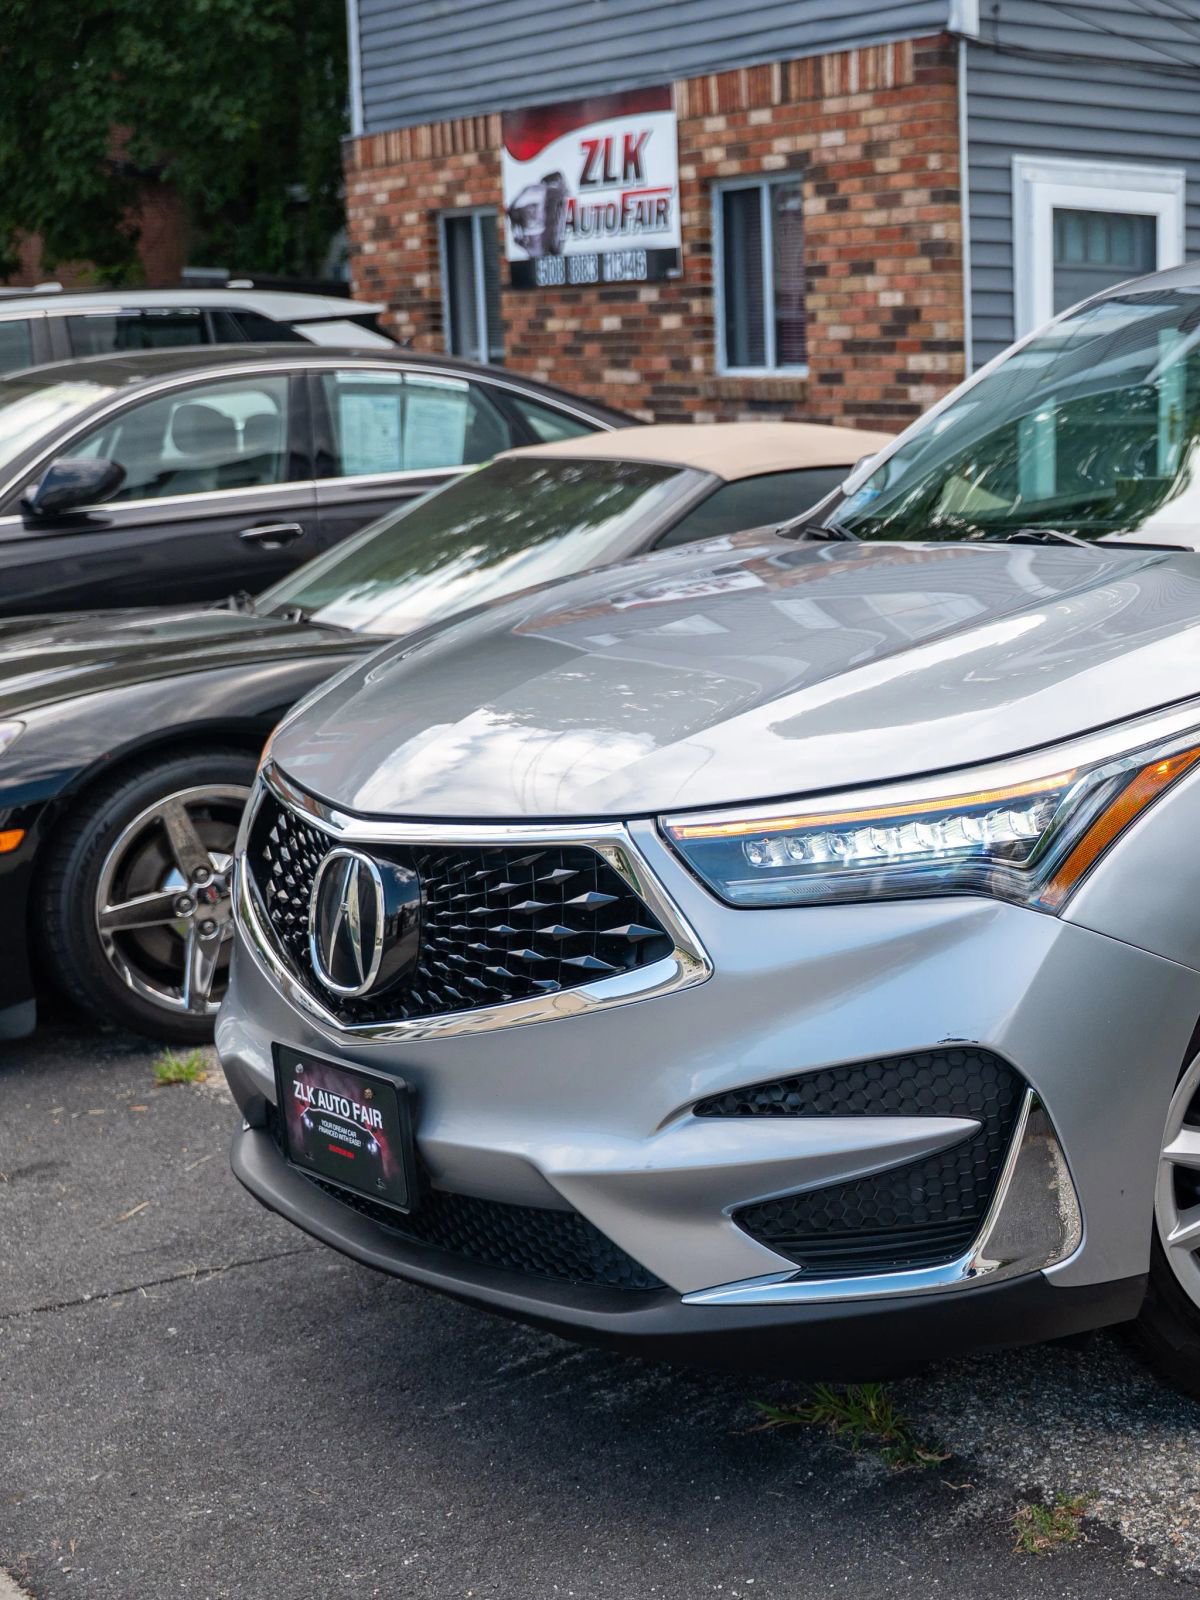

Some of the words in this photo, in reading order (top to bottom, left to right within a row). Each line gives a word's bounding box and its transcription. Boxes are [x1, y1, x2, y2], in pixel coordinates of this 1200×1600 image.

[579, 129, 653, 189] ZLK
[293, 1080, 316, 1105] ZLK
[318, 1090, 350, 1118] AUTO
[352, 1102, 383, 1130] FAIR
[318, 1125, 339, 1139] FINANCED
[321, 1119, 333, 1129] YOUR
[332, 1123, 348, 1135] DREAM
[347, 1129, 357, 1139] CAR
